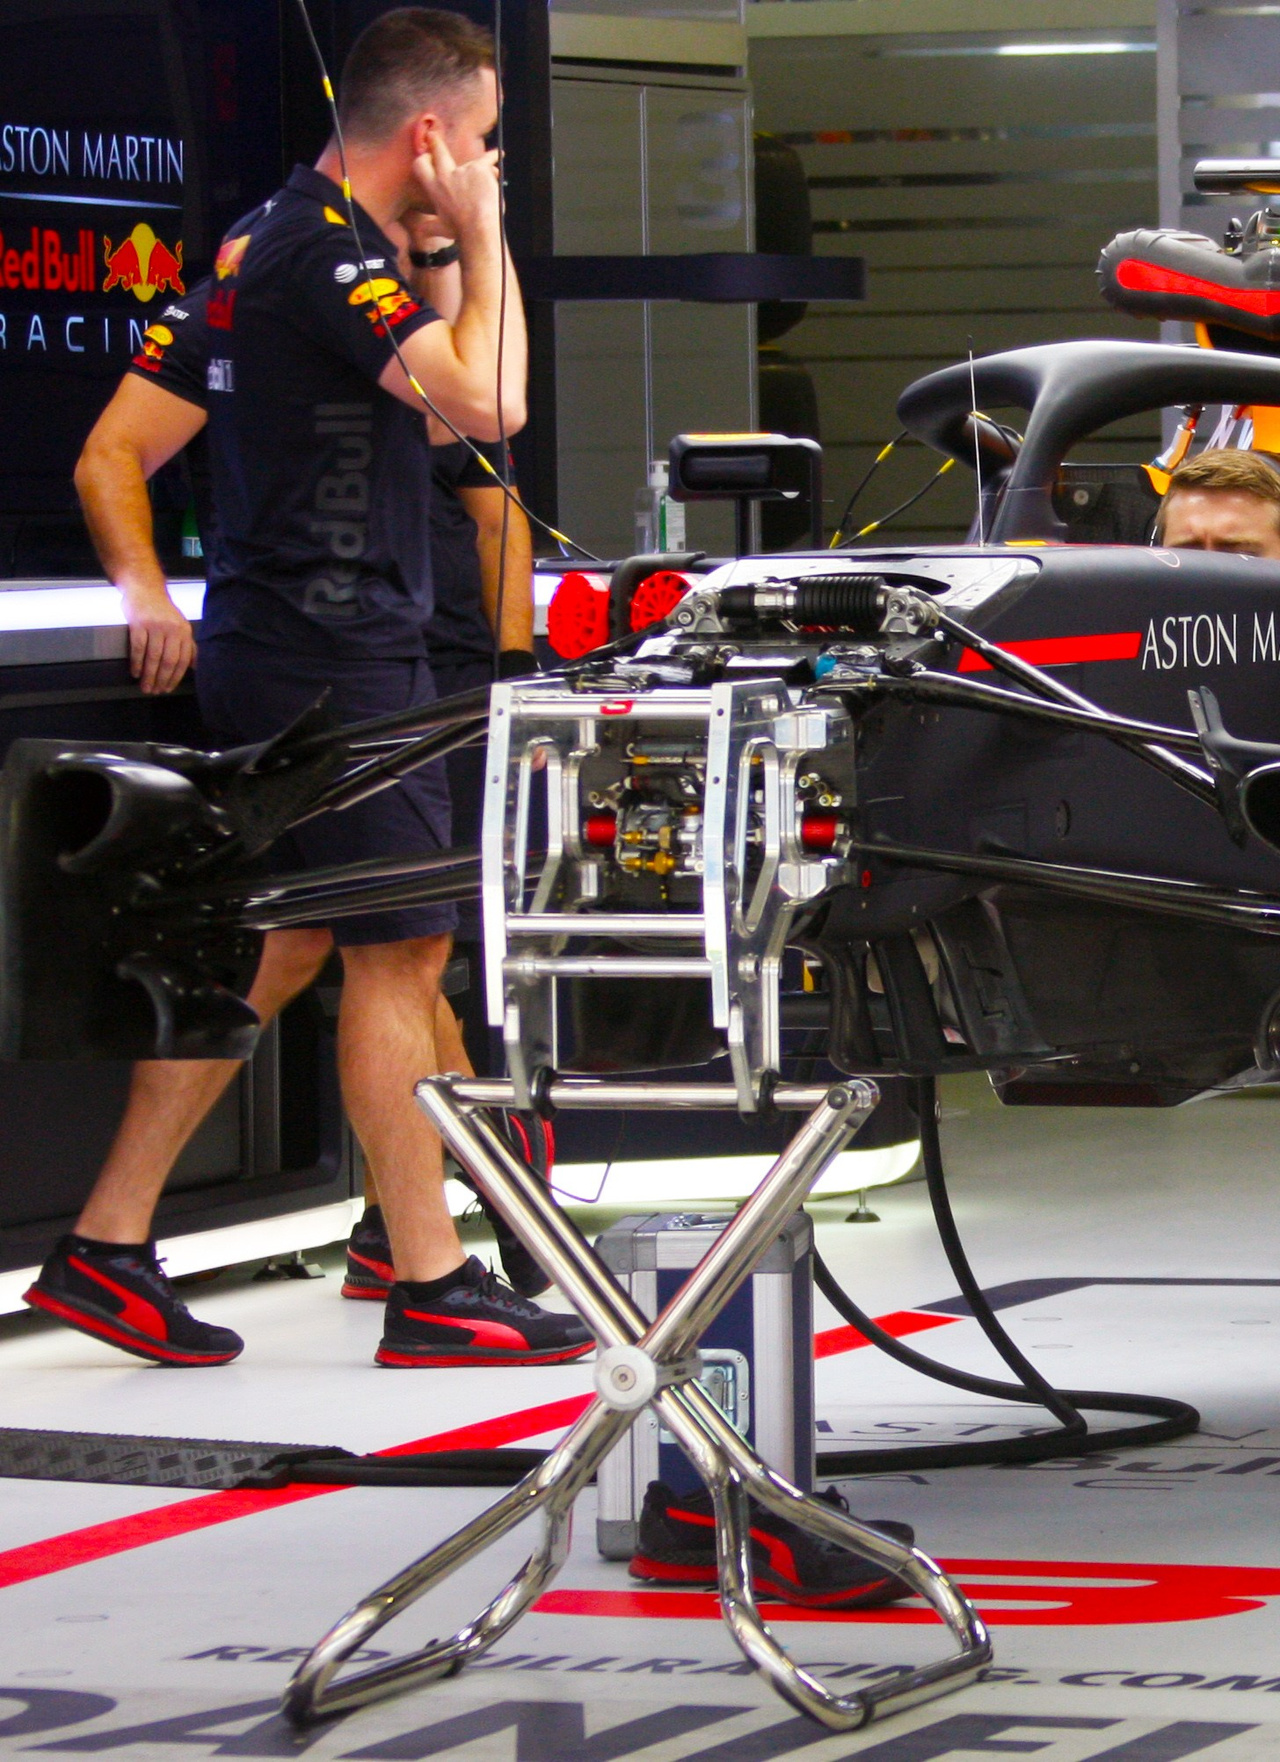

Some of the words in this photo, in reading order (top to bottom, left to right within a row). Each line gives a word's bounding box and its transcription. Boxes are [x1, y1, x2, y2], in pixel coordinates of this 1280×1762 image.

[0, 124, 70, 177] STON
[83, 131, 184, 186] MARTIN
[0, 226, 40, 290] ed
[43, 229, 95, 292] Bull
[0, 313, 149, 354] ACIN
[1142, 613, 1237, 670] ASTON
